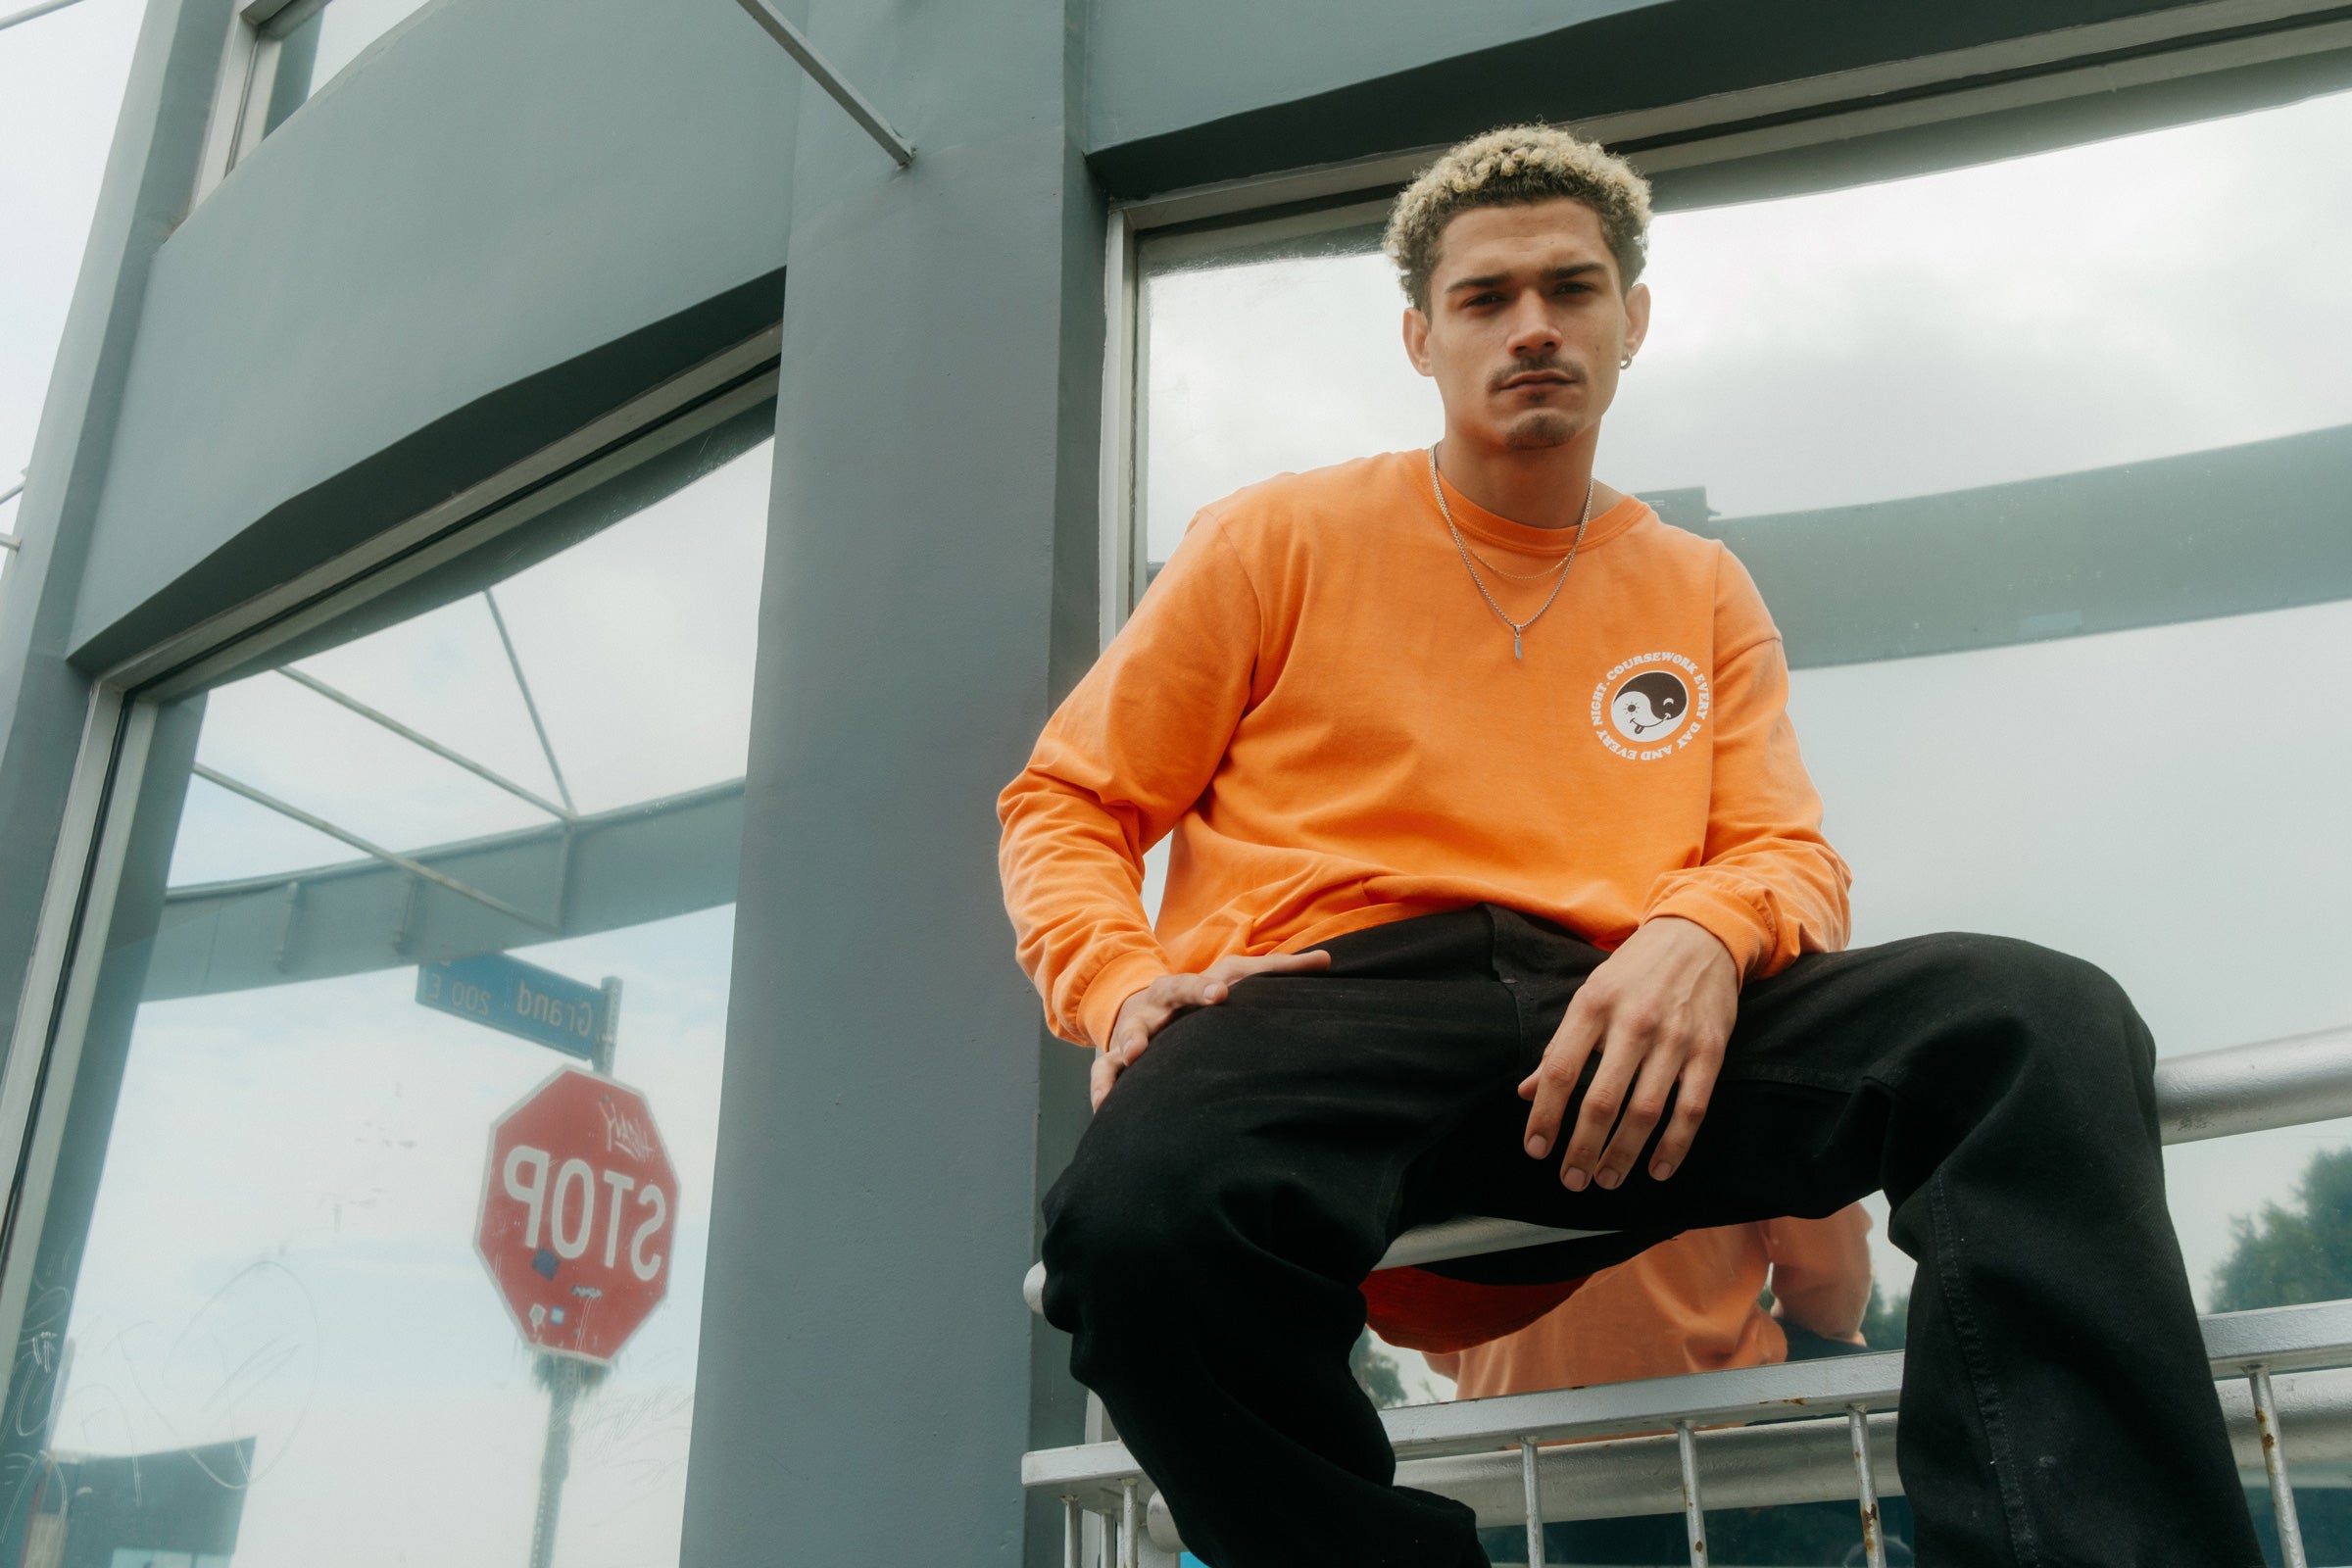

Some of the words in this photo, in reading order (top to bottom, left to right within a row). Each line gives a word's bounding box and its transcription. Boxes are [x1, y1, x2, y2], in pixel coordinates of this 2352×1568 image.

[1606, 651, 1698, 681] COURSEWORK
[1693, 673, 1710, 720] EVERY
[1595, 730, 1638, 760] EVERY
[1676, 721, 1702, 750] DAY
[1640, 744, 1673, 761] AND
